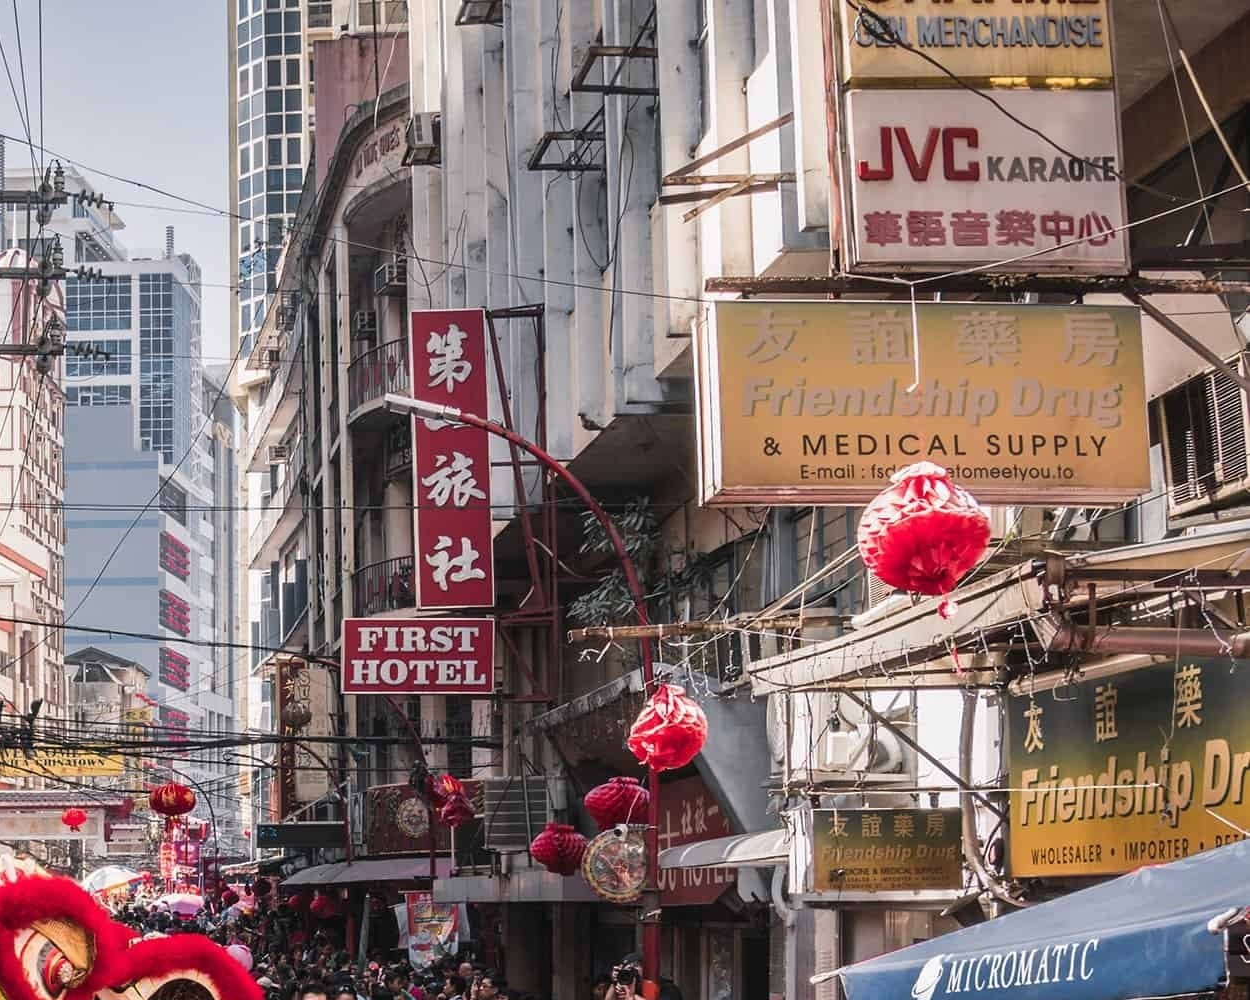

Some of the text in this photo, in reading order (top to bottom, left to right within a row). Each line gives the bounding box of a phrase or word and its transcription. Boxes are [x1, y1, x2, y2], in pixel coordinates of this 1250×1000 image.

[917, 15, 1103, 48] MERCHANDISE
[859, 126, 1116, 183] JVC KARAOKE
[863, 210, 1116, 247] 華語音樂中心
[741, 308, 1125, 368] 友誼藥房
[740, 375, 1124, 429] Friendship Drug
[763, 434, 1108, 457] & MEDICAL SUPPLY
[800, 463, 855, 480] E-mail
[357, 625, 480, 653] FIRST
[349, 658, 487, 686] HOTEL
[1021, 750, 1193, 829] Friendship
[828, 813, 945, 838] 友誼藥房
[1031, 845, 1102, 865] WHOLESALER
[1124, 838, 1190, 861] IMPORTER
[945, 938, 1099, 994] MICROMATIC
